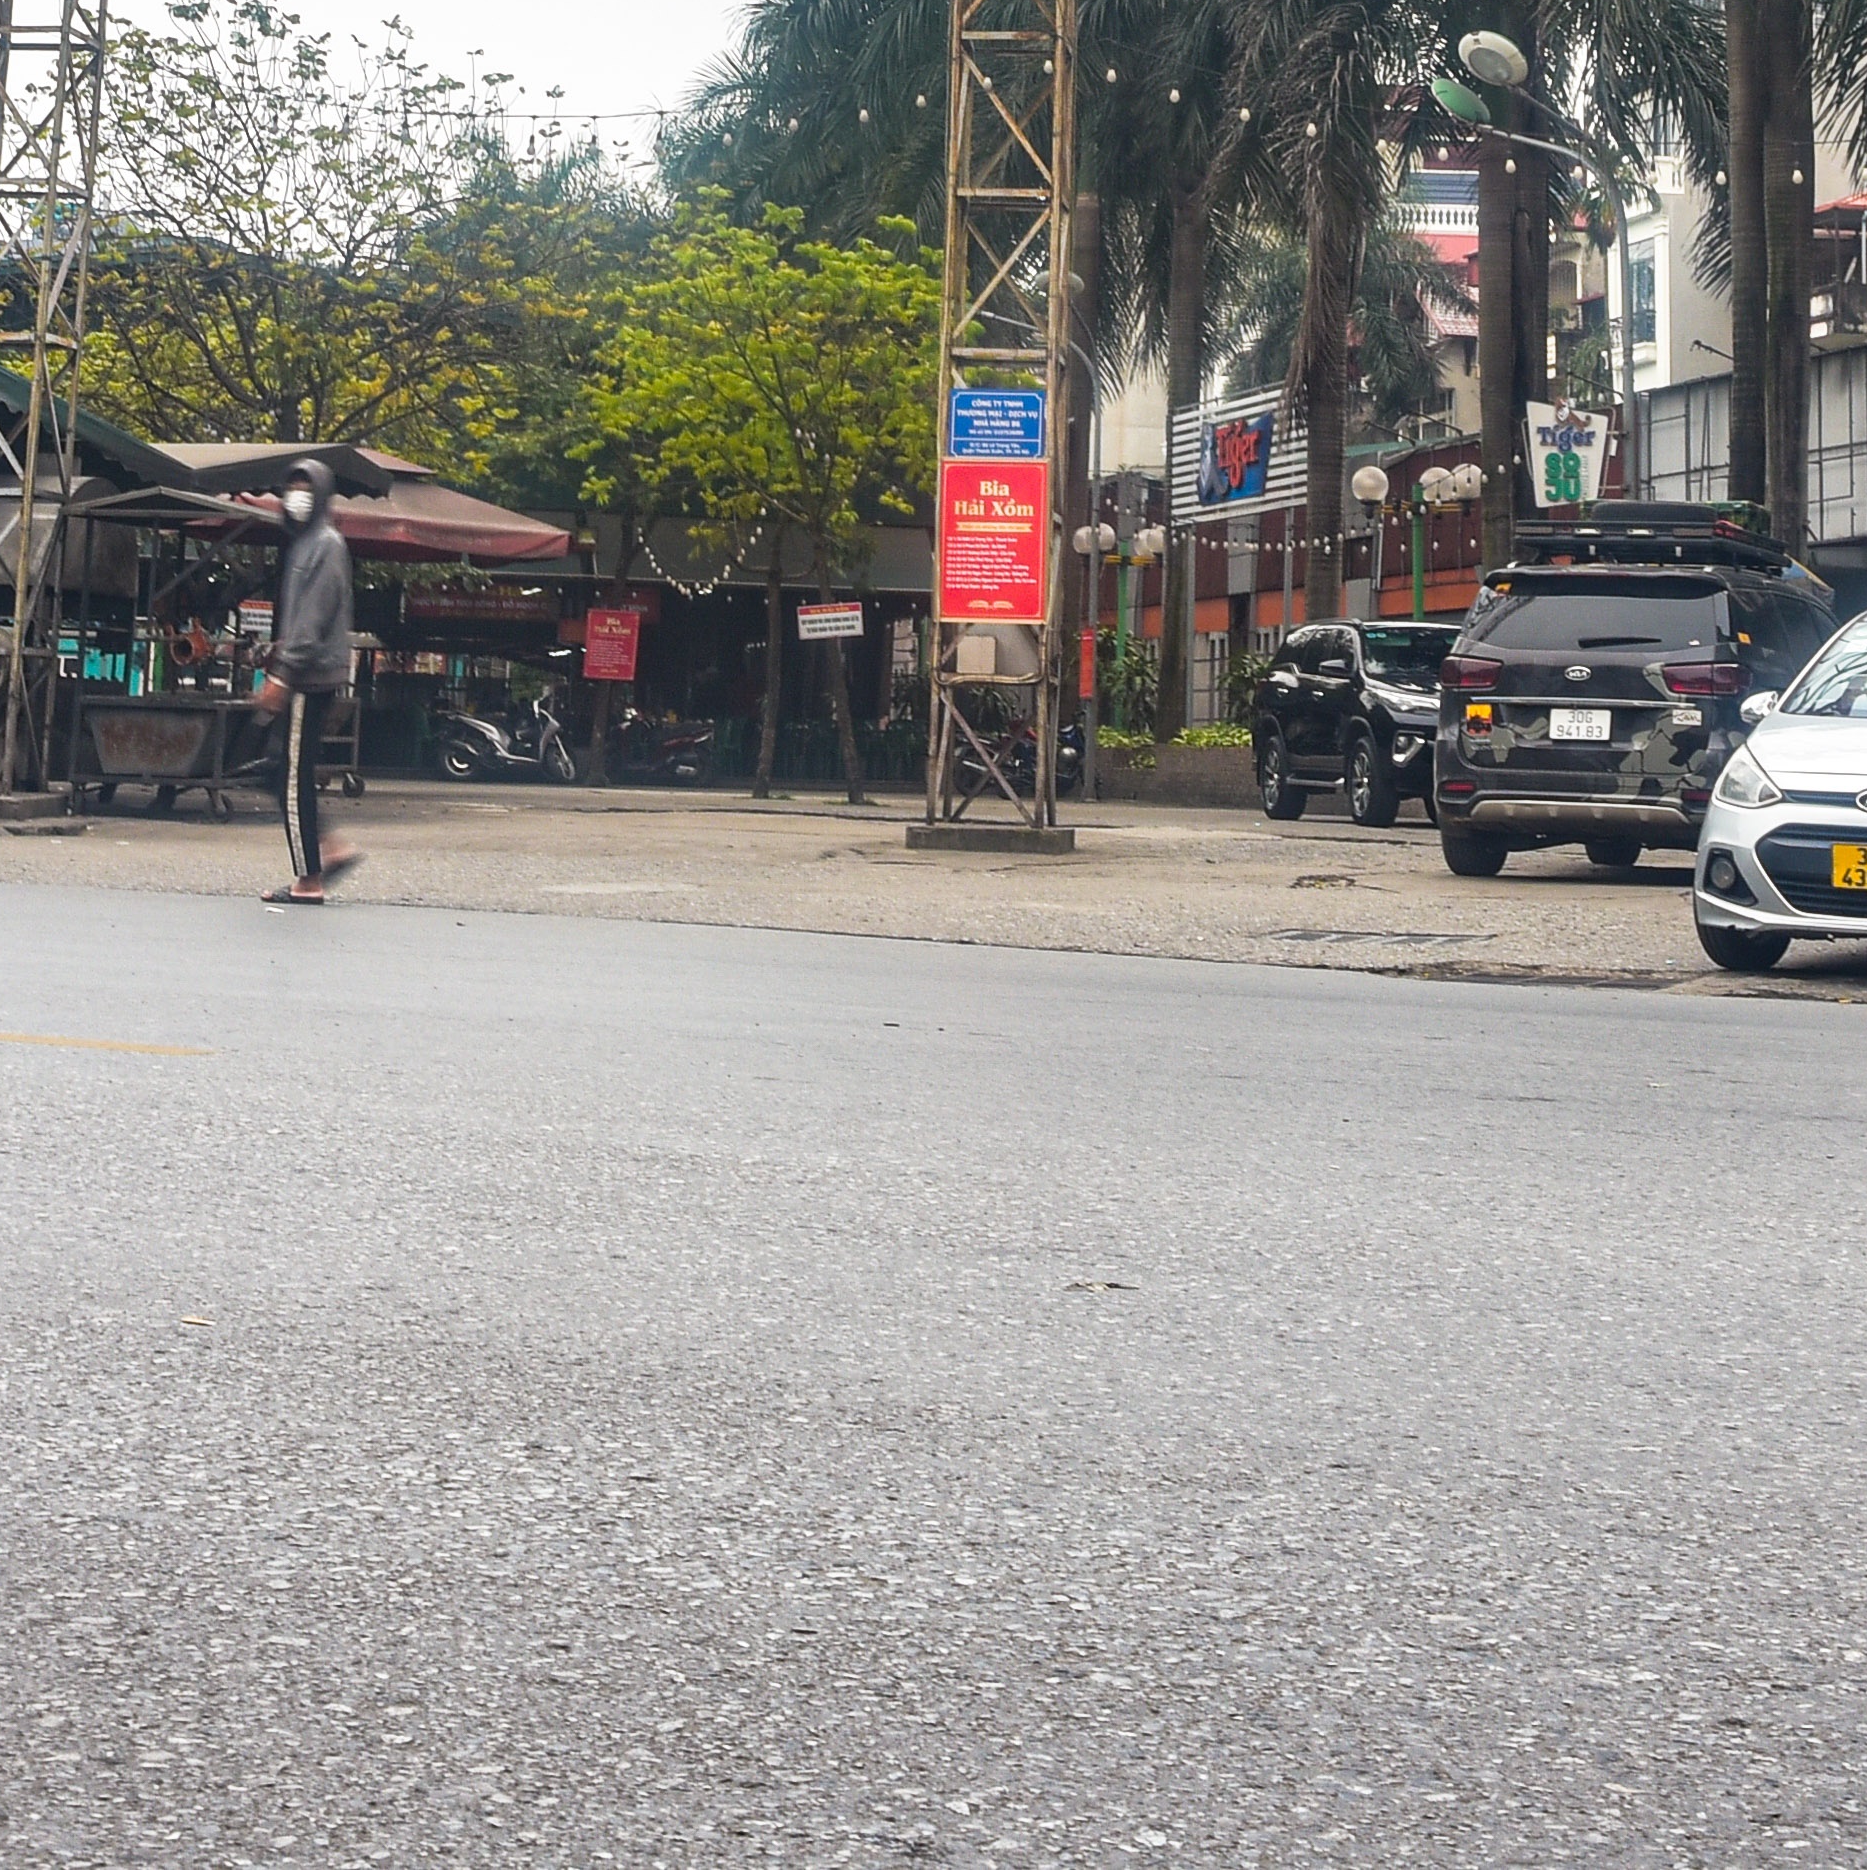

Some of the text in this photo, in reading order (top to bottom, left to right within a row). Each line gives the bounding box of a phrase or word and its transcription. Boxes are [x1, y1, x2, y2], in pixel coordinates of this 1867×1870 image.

[1537, 424, 1596, 453] Tiger
[1216, 418, 1261, 488] Tiger
[979, 479, 1010, 497] Bia
[954, 497, 1034, 517] Hải Xồm
[1567, 710, 1593, 723] 30G
[1556, 725, 1603, 739] 941.83
